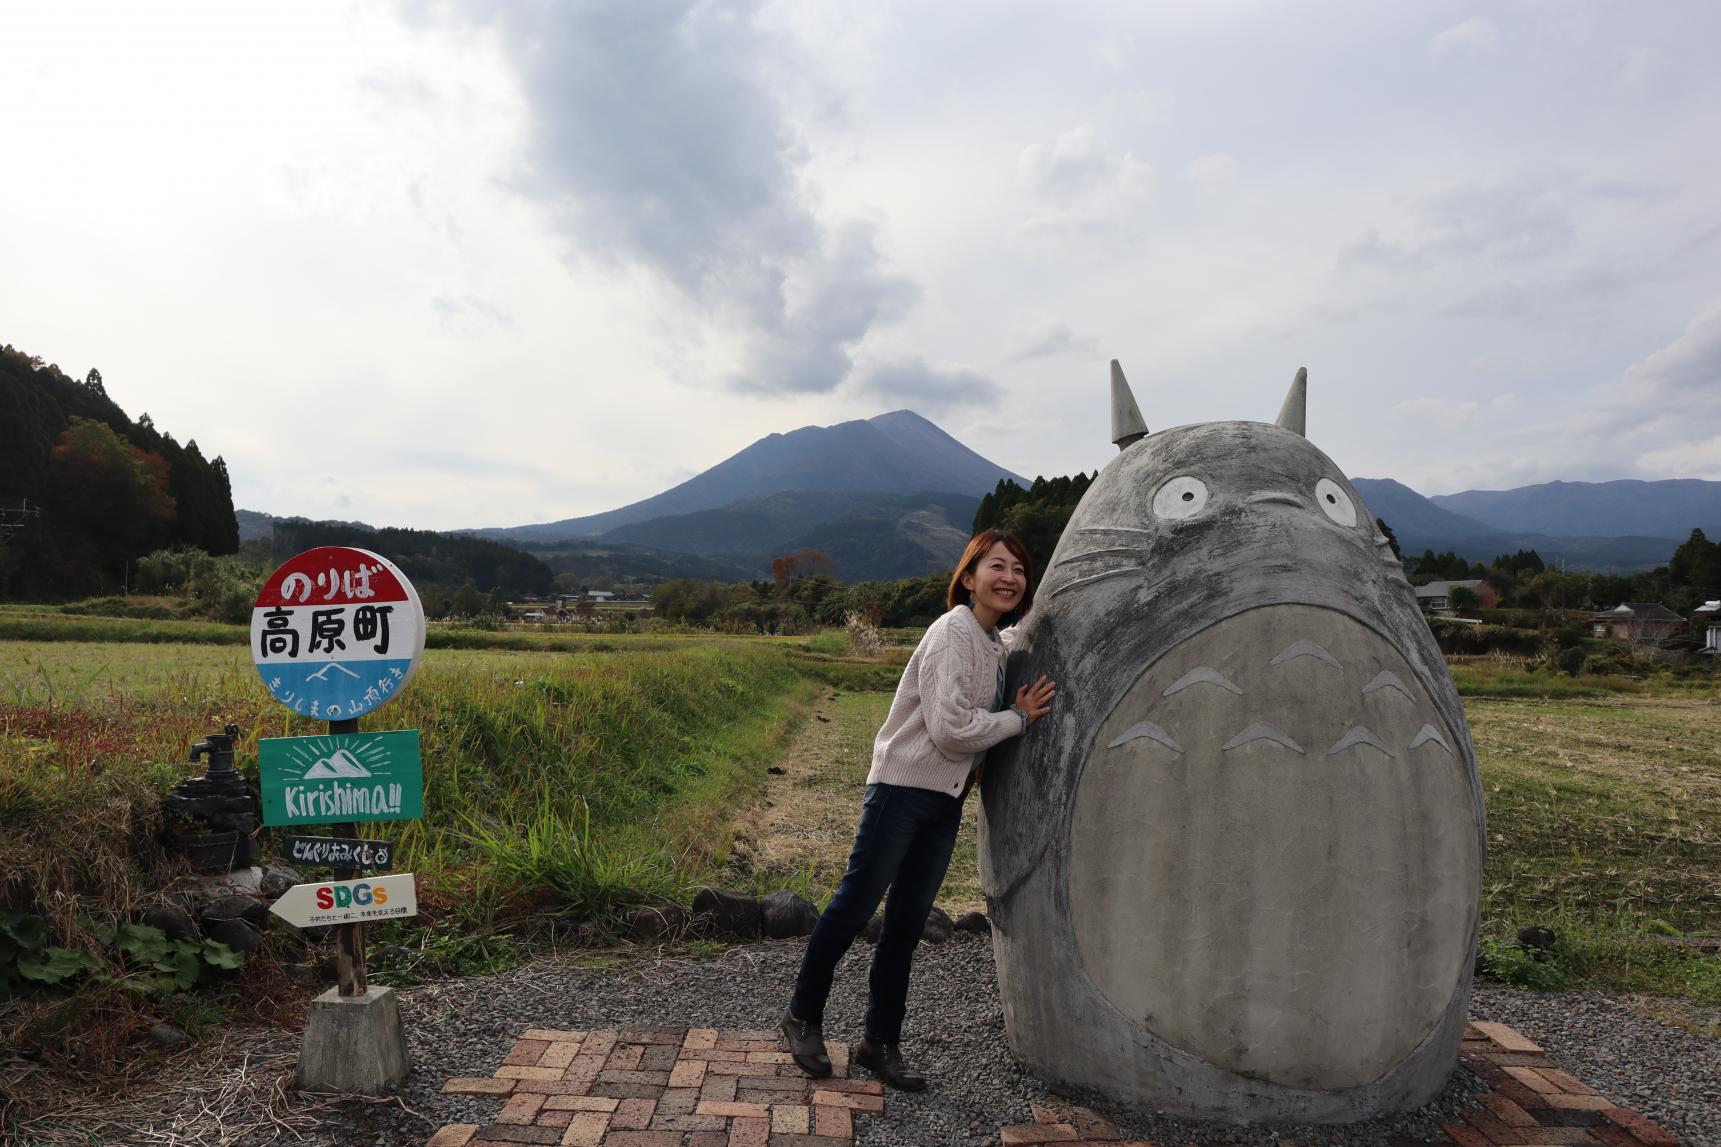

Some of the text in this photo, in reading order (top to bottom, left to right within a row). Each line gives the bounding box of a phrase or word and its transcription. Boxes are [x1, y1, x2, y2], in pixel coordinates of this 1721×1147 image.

[281, 563, 384, 602] のりば
[261, 606, 394, 658] 高原町
[268, 667, 405, 717] きりしまの山頂行き
[285, 781, 402, 818] Kirishima!!
[316, 883, 388, 910] SDGs
